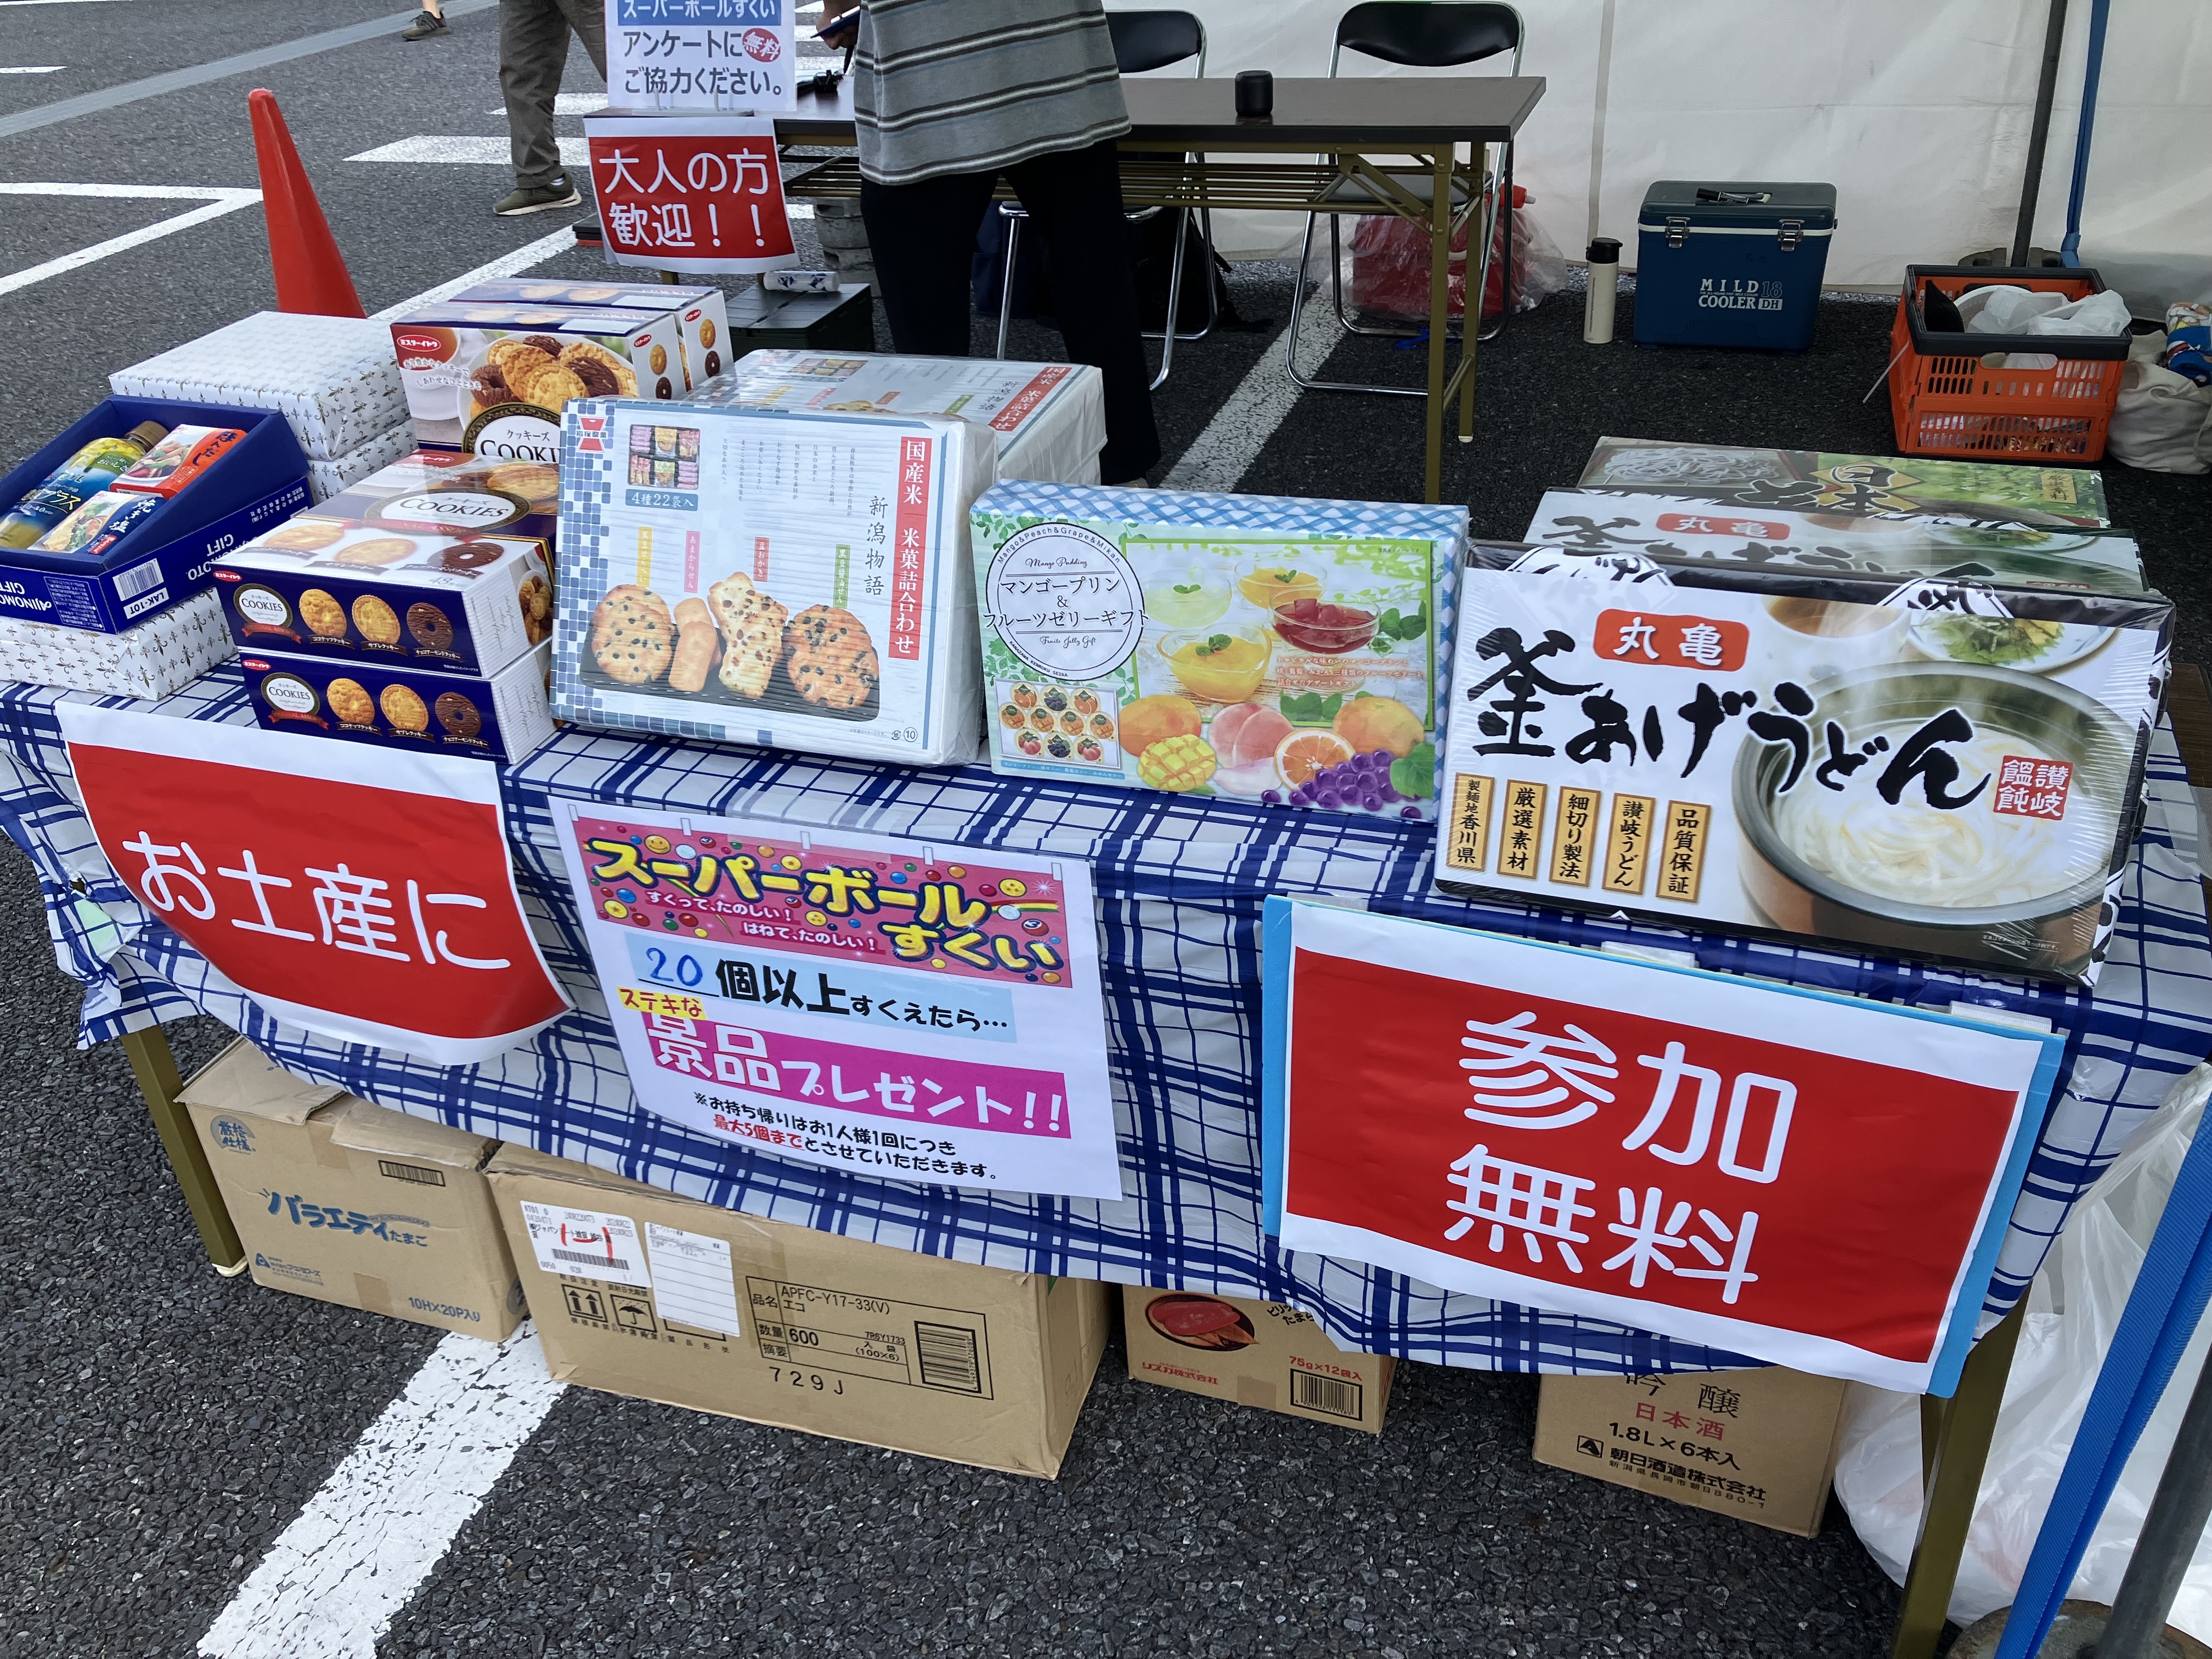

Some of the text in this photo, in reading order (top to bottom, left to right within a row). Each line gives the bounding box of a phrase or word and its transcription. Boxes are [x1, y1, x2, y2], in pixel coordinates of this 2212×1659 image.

[623, 30, 781, 61] アンケートに 無料
[625, 65, 782, 95] ご協力ください。
[599, 148, 768, 194] 大人の方
[1699, 295, 1779, 309] COOLER DH
[1700, 279, 1782, 298] MILD 18
[400, 338, 438, 348] ミスターイトウ
[506, 430, 550, 441] クッキーズ
[903, 440, 926, 505] 国産米
[400, 498, 509, 518] COOKIES
[631, 491, 695, 509] 4種22袋入
[1674, 516, 1769, 538] 丸亀
[206, 533, 235, 557] GIFT
[757, 541, 766, 578] 豆おかき
[864, 495, 889, 596] 新潟物語
[997, 526, 1121, 564] Mango&Peach&Grape&Mikan
[214, 572, 241, 581] ミスターイトウ
[687, 535, 697, 589] あまからせん
[1025, 557, 1088, 568] Mango Pudding
[894, 527, 920, 656] 米菓詰合わせ
[1000, 576, 1121, 595] マンゴープリン
[1057, 596, 1069, 608] &
[130, 592, 165, 616] LAK-10T
[241, 597, 283, 612] COOKIES
[983, 609, 1150, 629] フルーツゼリーギフト
[1009, 640, 1029, 662] KANAZAWA
[1030, 659, 1051, 673] KENROKU
[1040, 635, 1097, 648] Fruits Jelly Gift
[1613, 616, 1722, 666] 丸亀
[244, 661, 270, 669] ミスターイトウ
[269, 686, 311, 701] COOKIES
[1467, 627, 1992, 810] 釜あげうどん
[1457, 779, 1481, 864] 製麺地香川県
[1506, 787, 1536, 871] 厳選素材
[1559, 794, 1589, 879] 細切り製法
[1613, 800, 1644, 887] 讃岐うどん
[1667, 809, 1699, 895] 品質保証
[584, 834, 995, 930] スーパーボール
[122, 830, 511, 969] お土産に
[648, 889, 794, 922] すくって、たのしい！
[742, 921, 878, 952] はねて、たのしい！
[880, 919, 1064, 975] すくい
[644, 947, 704, 988] 20
[618, 986, 703, 1019] ステキな
[1459, 1011, 1798, 1184] 参加
[713, 1114, 997, 1181] 最大5個までとさせていただきます。
[267, 1191, 428, 1248] バラエティたまご
[1443, 1143, 1760, 1305] 無料
[752, 1294, 778, 1309] 品名
[781, 1285, 890, 1314] APFC-Y17-33(V)
[783, 1300, 805, 1312] エコ
[758, 1324, 783, 1339] 数量
[789, 1328, 819, 1346] 600
[1142, 1362, 1219, 1385] リスカ株式会社
[1635, 1402, 1726, 1441] 日本酒
[1609, 1422, 1741, 1471] 1.8L×6本入
[1610, 1447, 1767, 1502] 朝日酒造株式会社
